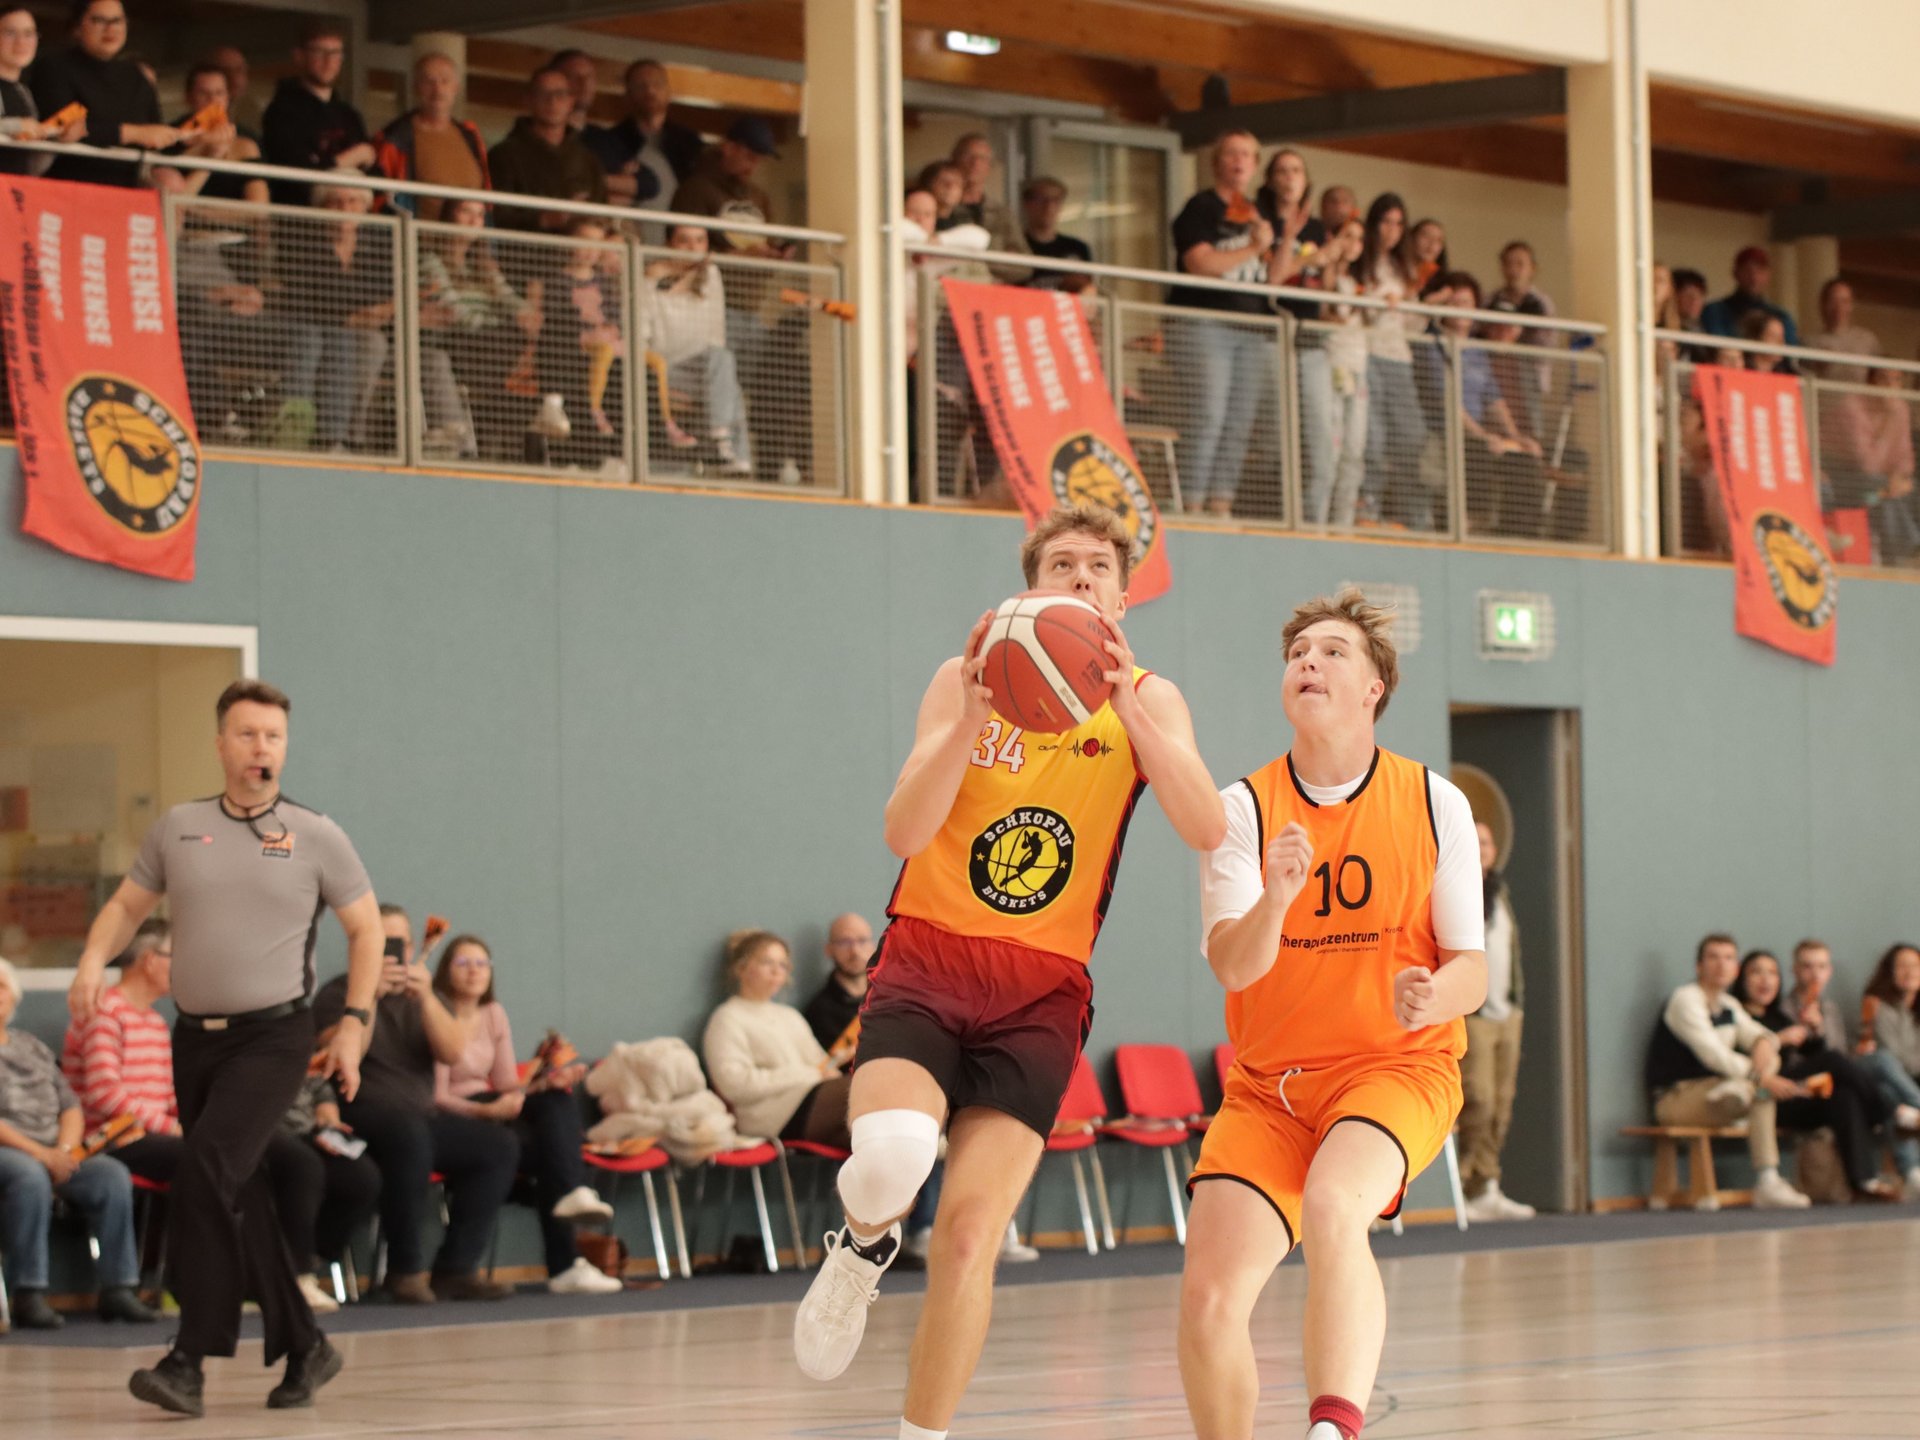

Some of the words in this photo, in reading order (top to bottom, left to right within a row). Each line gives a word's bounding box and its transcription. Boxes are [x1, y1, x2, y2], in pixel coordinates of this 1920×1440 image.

[81, 234, 113, 347] DEFENSE
[129, 213, 163, 334] DEFENSE
[132, 392, 197, 529] SCHKOPAU
[970, 720, 1025, 773] 34
[983, 811, 1073, 848] SCHKOPAU
[981, 885, 1047, 908] BASKETS
[1314, 854, 1373, 917] 10
[1280, 931, 1379, 951] Therapiezentrum
